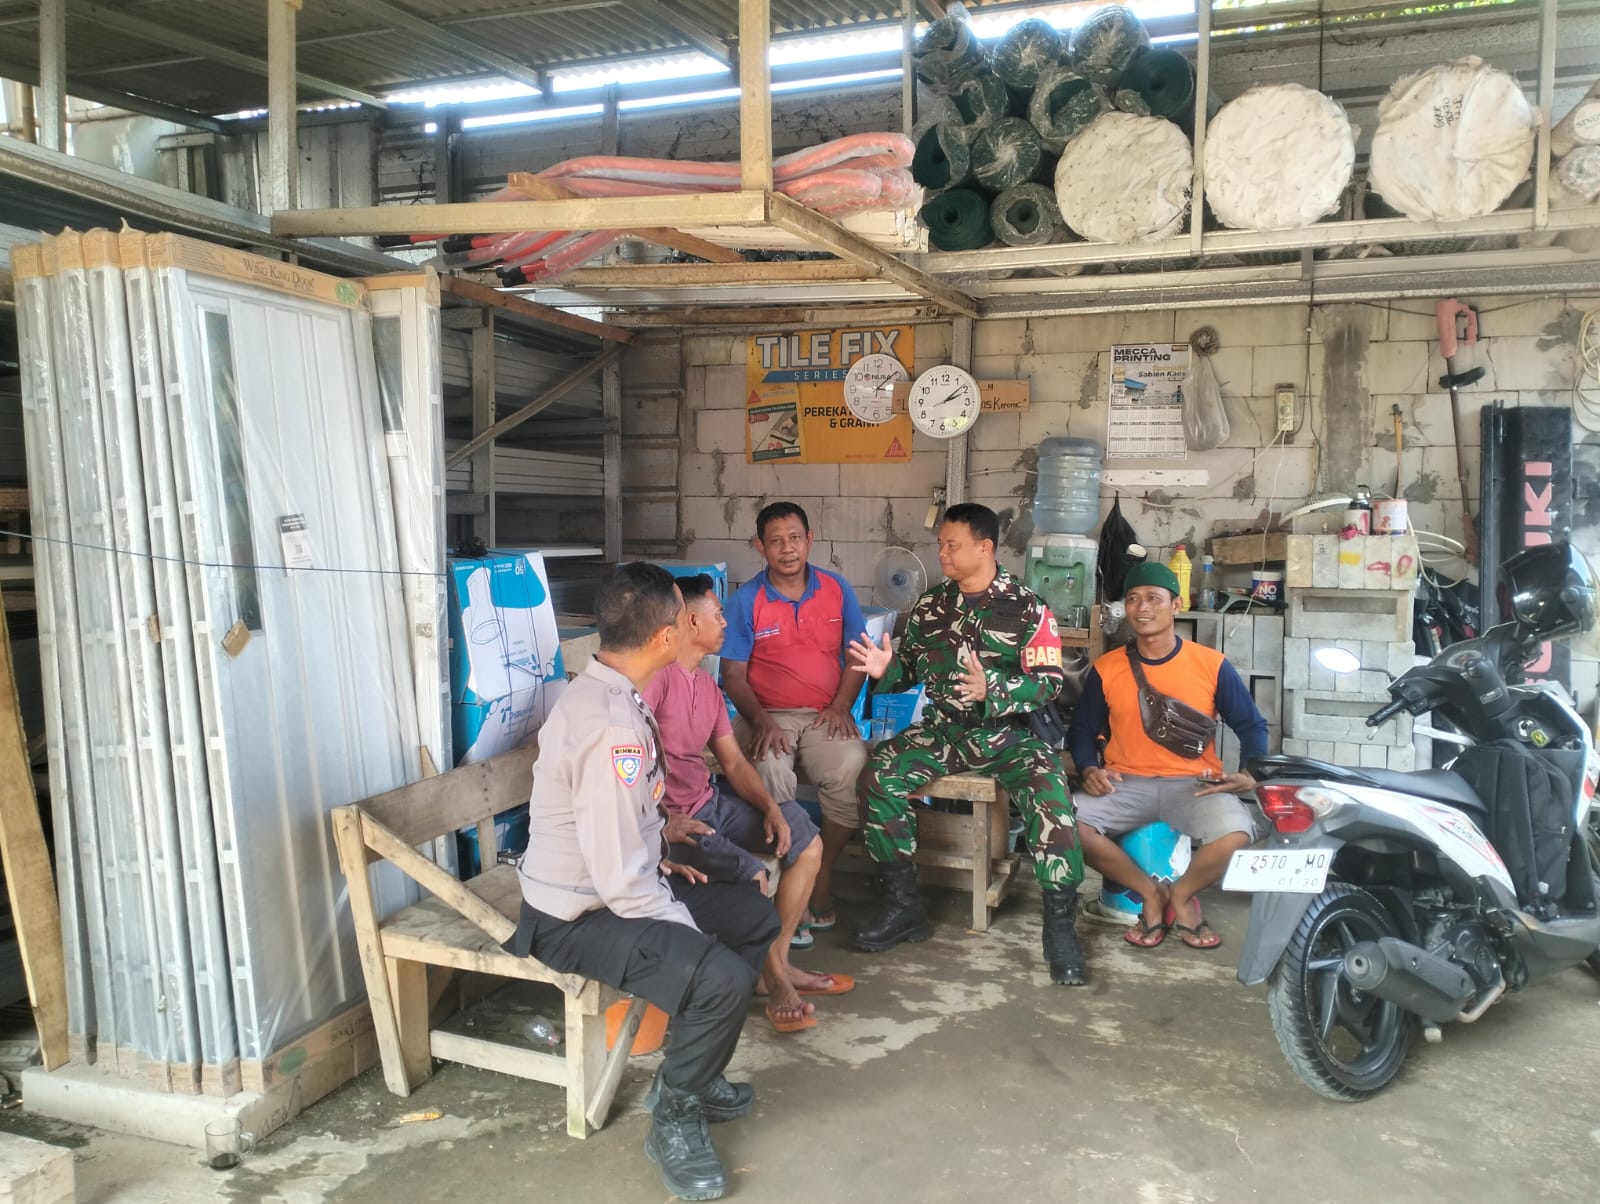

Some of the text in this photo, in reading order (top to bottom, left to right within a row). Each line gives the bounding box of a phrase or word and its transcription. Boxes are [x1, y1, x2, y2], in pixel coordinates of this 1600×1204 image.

[756, 330, 899, 369] TILE FIX
[1114, 354, 1171, 362] PRINTING
[794, 369, 848, 380] SERIES
[1259, 585, 1277, 594] NO
[1235, 855, 1243, 868] T
[1251, 855, 1287, 869] 2570
